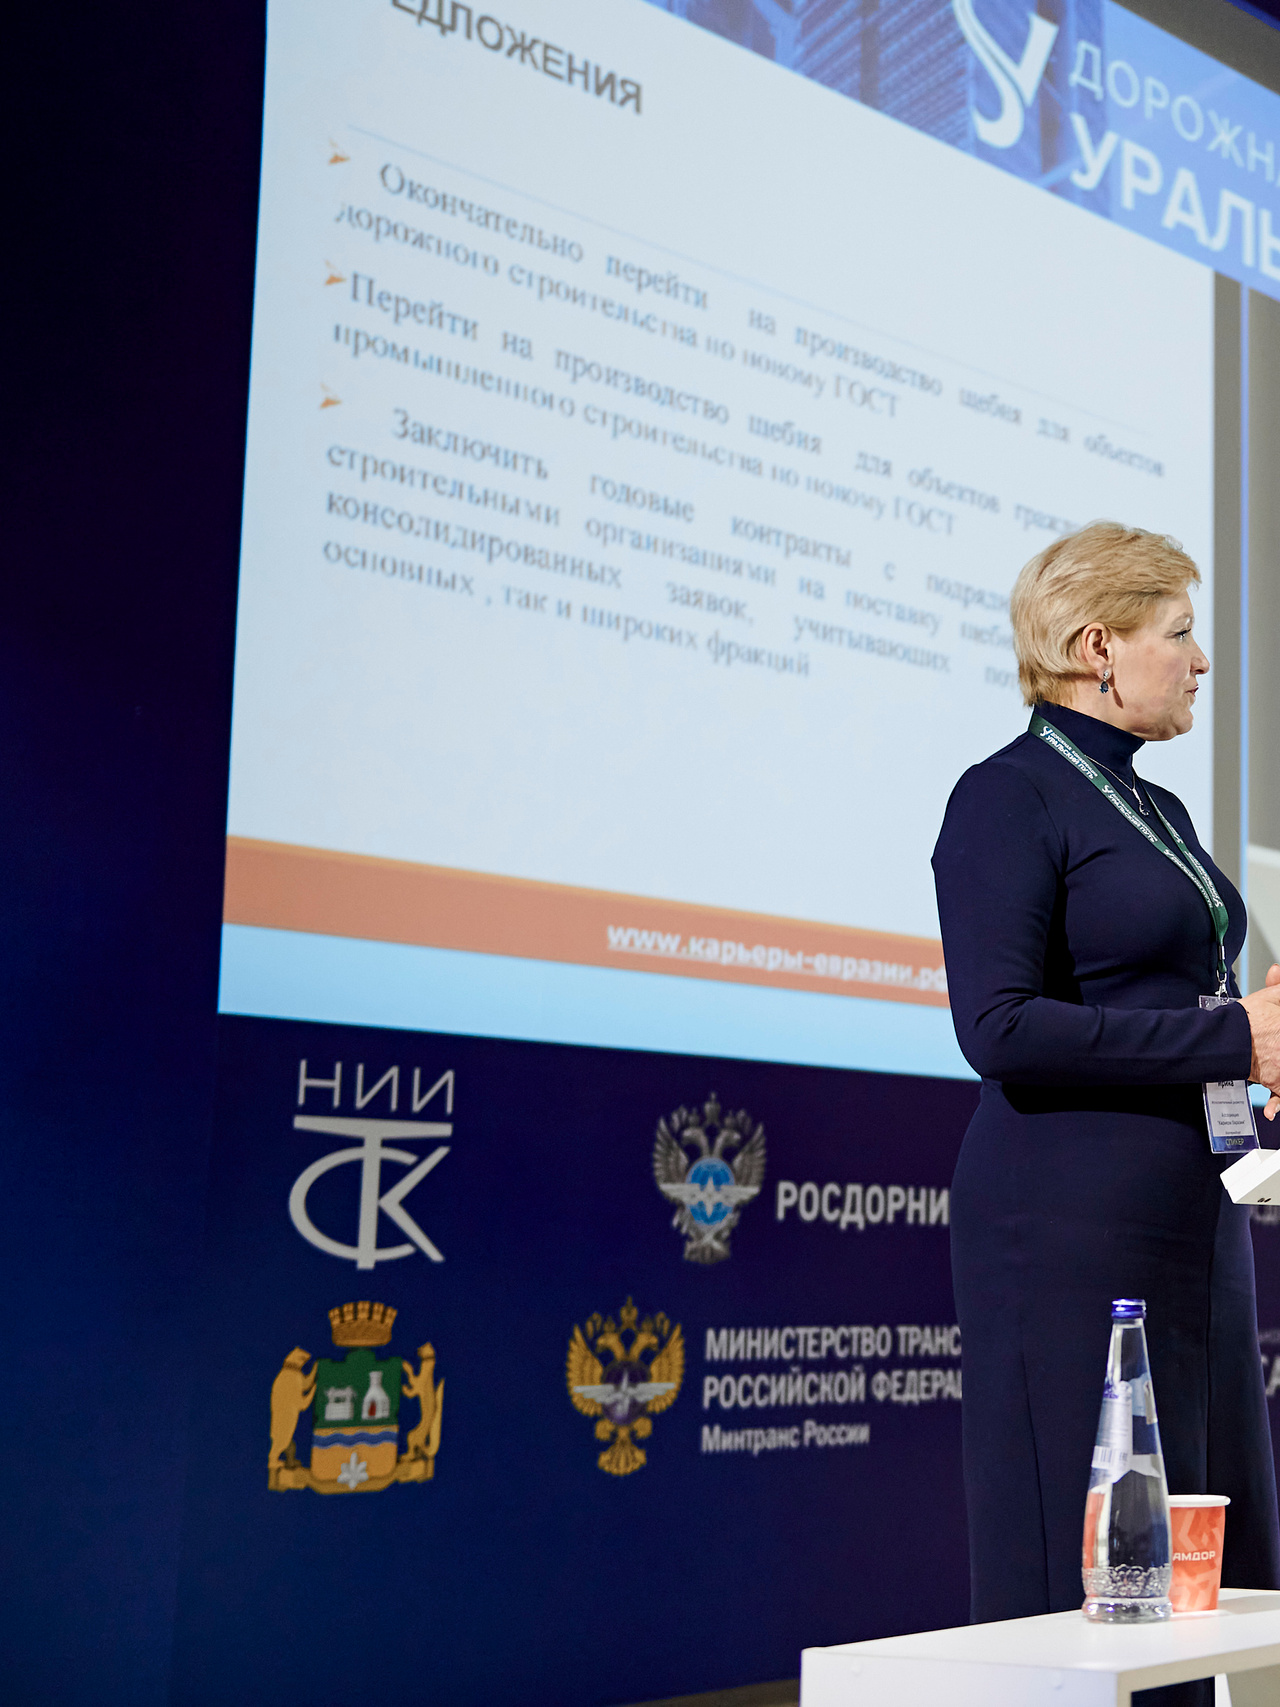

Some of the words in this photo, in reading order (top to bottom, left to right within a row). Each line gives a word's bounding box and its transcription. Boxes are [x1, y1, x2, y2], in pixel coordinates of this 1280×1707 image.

[392, 0, 642, 115] ДЛОЖЕНИЯ
[334, 204, 499, 278] дорожного
[509, 263, 698, 347] строительства
[705, 336, 735, 362] по
[743, 350, 827, 399] новому
[834, 375, 898, 418] ГОСТ
[380, 163, 585, 263] Окончательно
[606, 254, 709, 310] перейти
[747, 307, 777, 336] на
[795, 326, 943, 397] производство
[1036, 416, 1071, 443] для
[1084, 432, 1166, 477] объектов
[333, 322, 575, 418] промышленного
[584, 404, 764, 478] строительства
[771, 461, 799, 488] по
[806, 476, 886, 520] новому
[894, 497, 957, 537] ГОСТ
[350, 272, 479, 342] Перейти
[502, 330, 532, 360] на
[555, 347, 729, 427] производство
[855, 449, 893, 478] для
[908, 465, 1000, 514] объектов
[326, 445, 560, 527] строительными
[585, 514, 777, 586] организациями
[799, 575, 825, 600] на
[845, 589, 941, 637] поставку
[391, 408, 548, 481] Заключить
[590, 473, 695, 522] годовые
[731, 515, 852, 568] контракты
[884, 562, 896, 581] с
[323, 541, 474, 597] основных
[501, 584, 548, 612] так
[558, 602, 572, 620] и
[581, 603, 698, 652] широких
[706, 629, 811, 677] фракций
[326, 490, 623, 589] консолидированных
[666, 580, 754, 627] заявок,
[793, 614, 950, 673] учитывающих
[1046, 734, 1080, 766] УРАЛЬСКИЙ
[1078, 763, 1095, 780] ПУТЬ
[1108, 794, 1141, 827] УРАЛЬСКИЙ
[1139, 825, 1155, 843] ПУТЬ
[297, 1058, 455, 1115] НИИ
[1225, 1138, 1244, 1146] СПИКЕР
[702, 1365, 867, 1411] РОССИЙСКОЙ
[705, 1325, 893, 1362] МИНИСТЕРСТВО
[896, 1324, 962, 1358] ТРАНС
[701, 1424, 800, 1457] Минтранс
[803, 1419, 870, 1449] России
[1172, 1550, 1216, 1561] АМДОР
